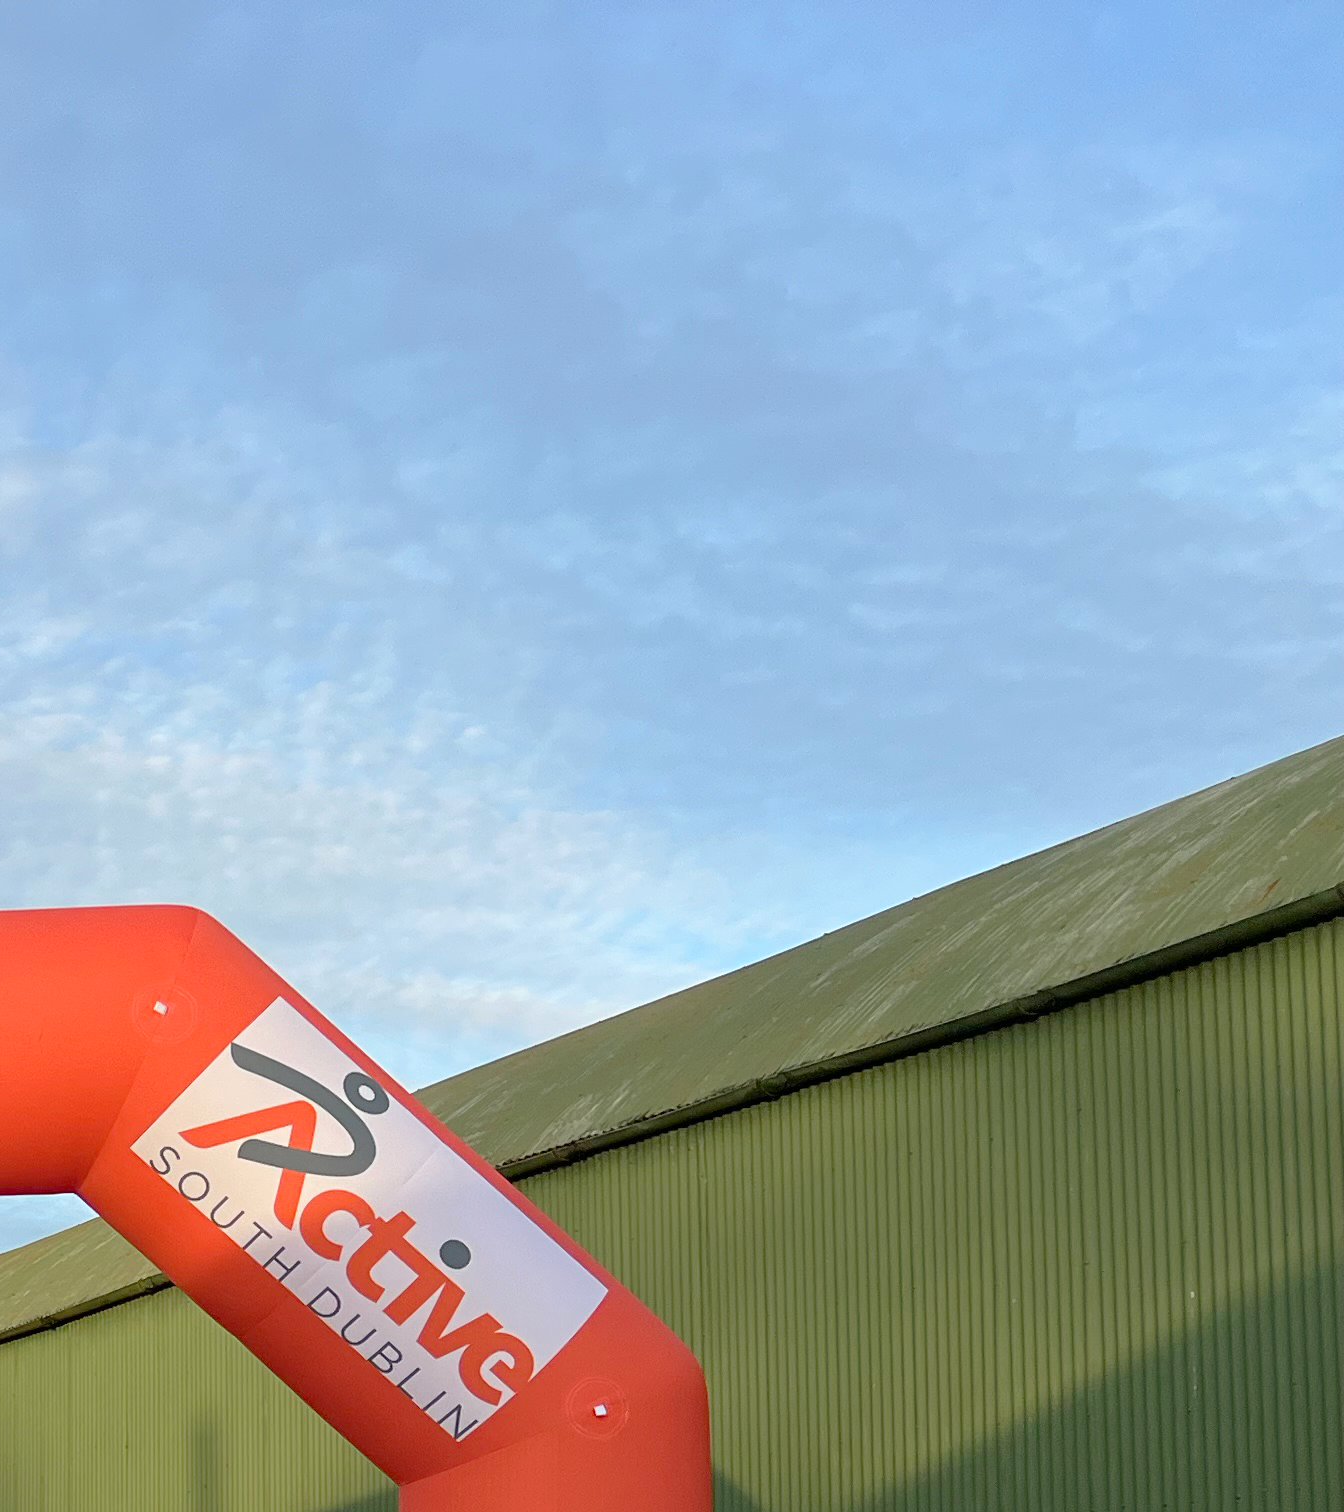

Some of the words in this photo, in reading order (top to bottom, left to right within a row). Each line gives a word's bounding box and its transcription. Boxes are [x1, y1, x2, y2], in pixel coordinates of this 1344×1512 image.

[149, 1146, 302, 1285] SOUTH
[308, 1286, 480, 1443] DUBLIN
[178, 1042, 535, 1406] Active
